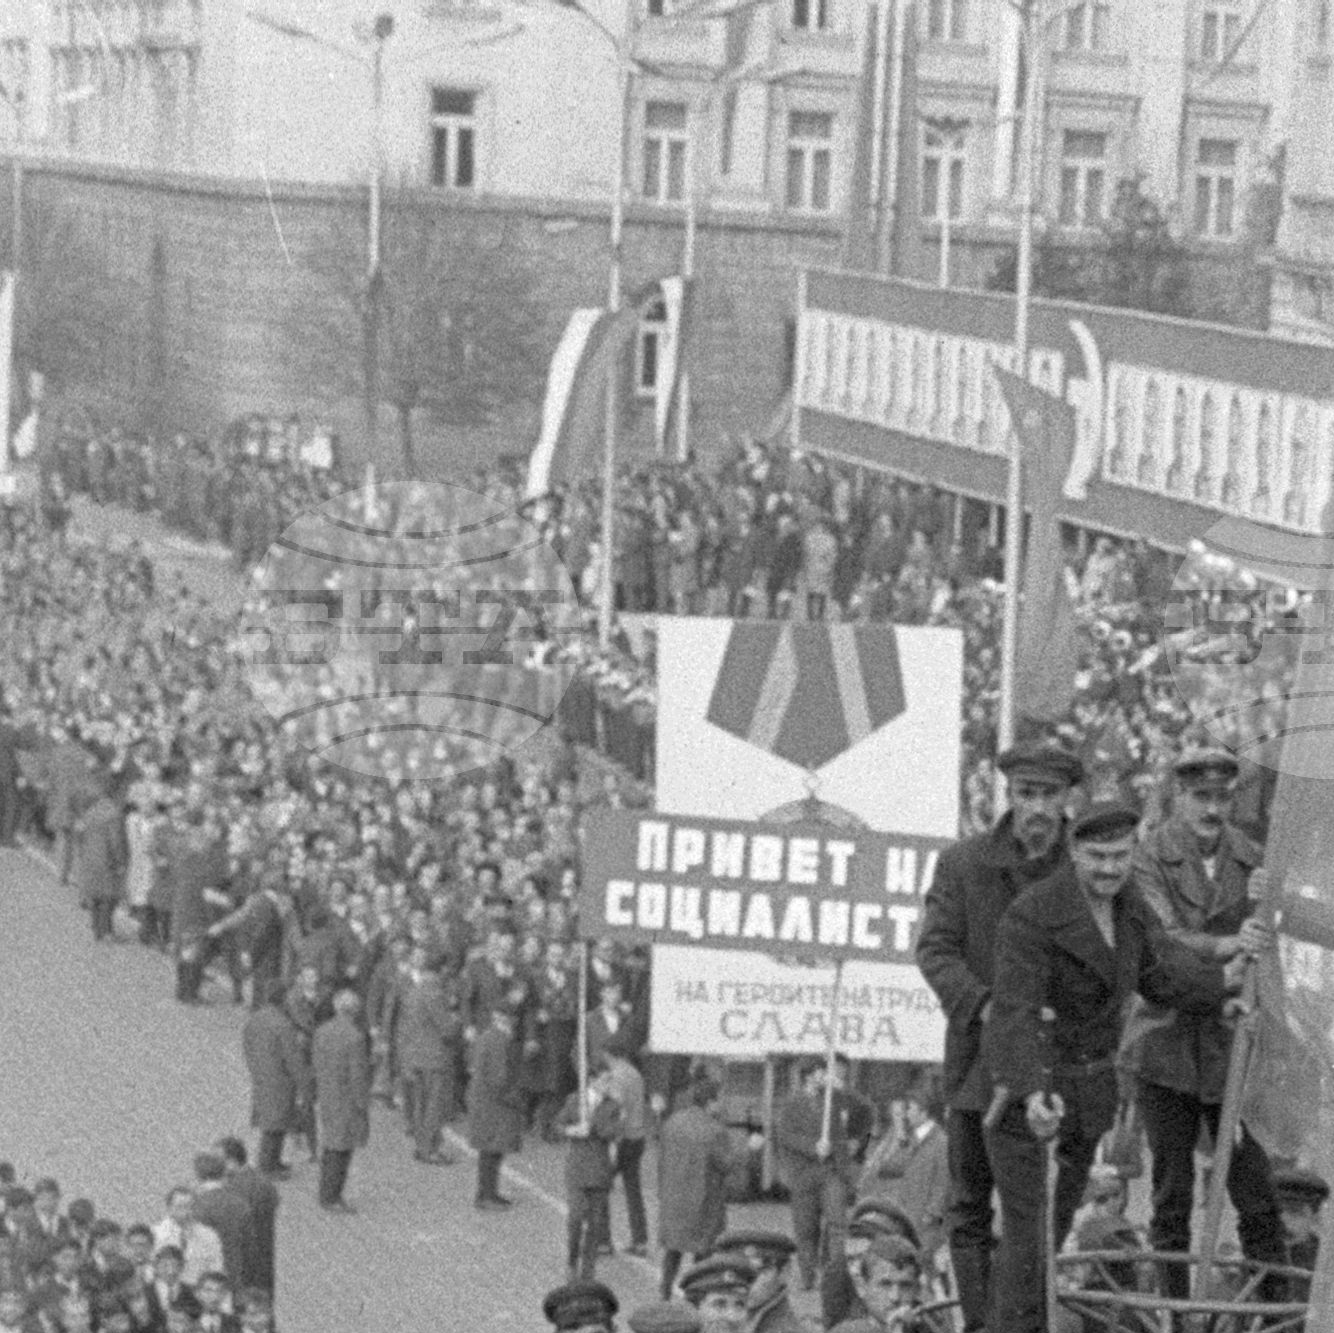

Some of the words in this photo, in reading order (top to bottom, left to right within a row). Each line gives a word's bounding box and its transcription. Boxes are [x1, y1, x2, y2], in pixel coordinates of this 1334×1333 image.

[637, 820, 855, 886] ПРИВЕТ
[676, 980, 709, 1004] НА
[719, 1010, 902, 1046] СЛАВА
